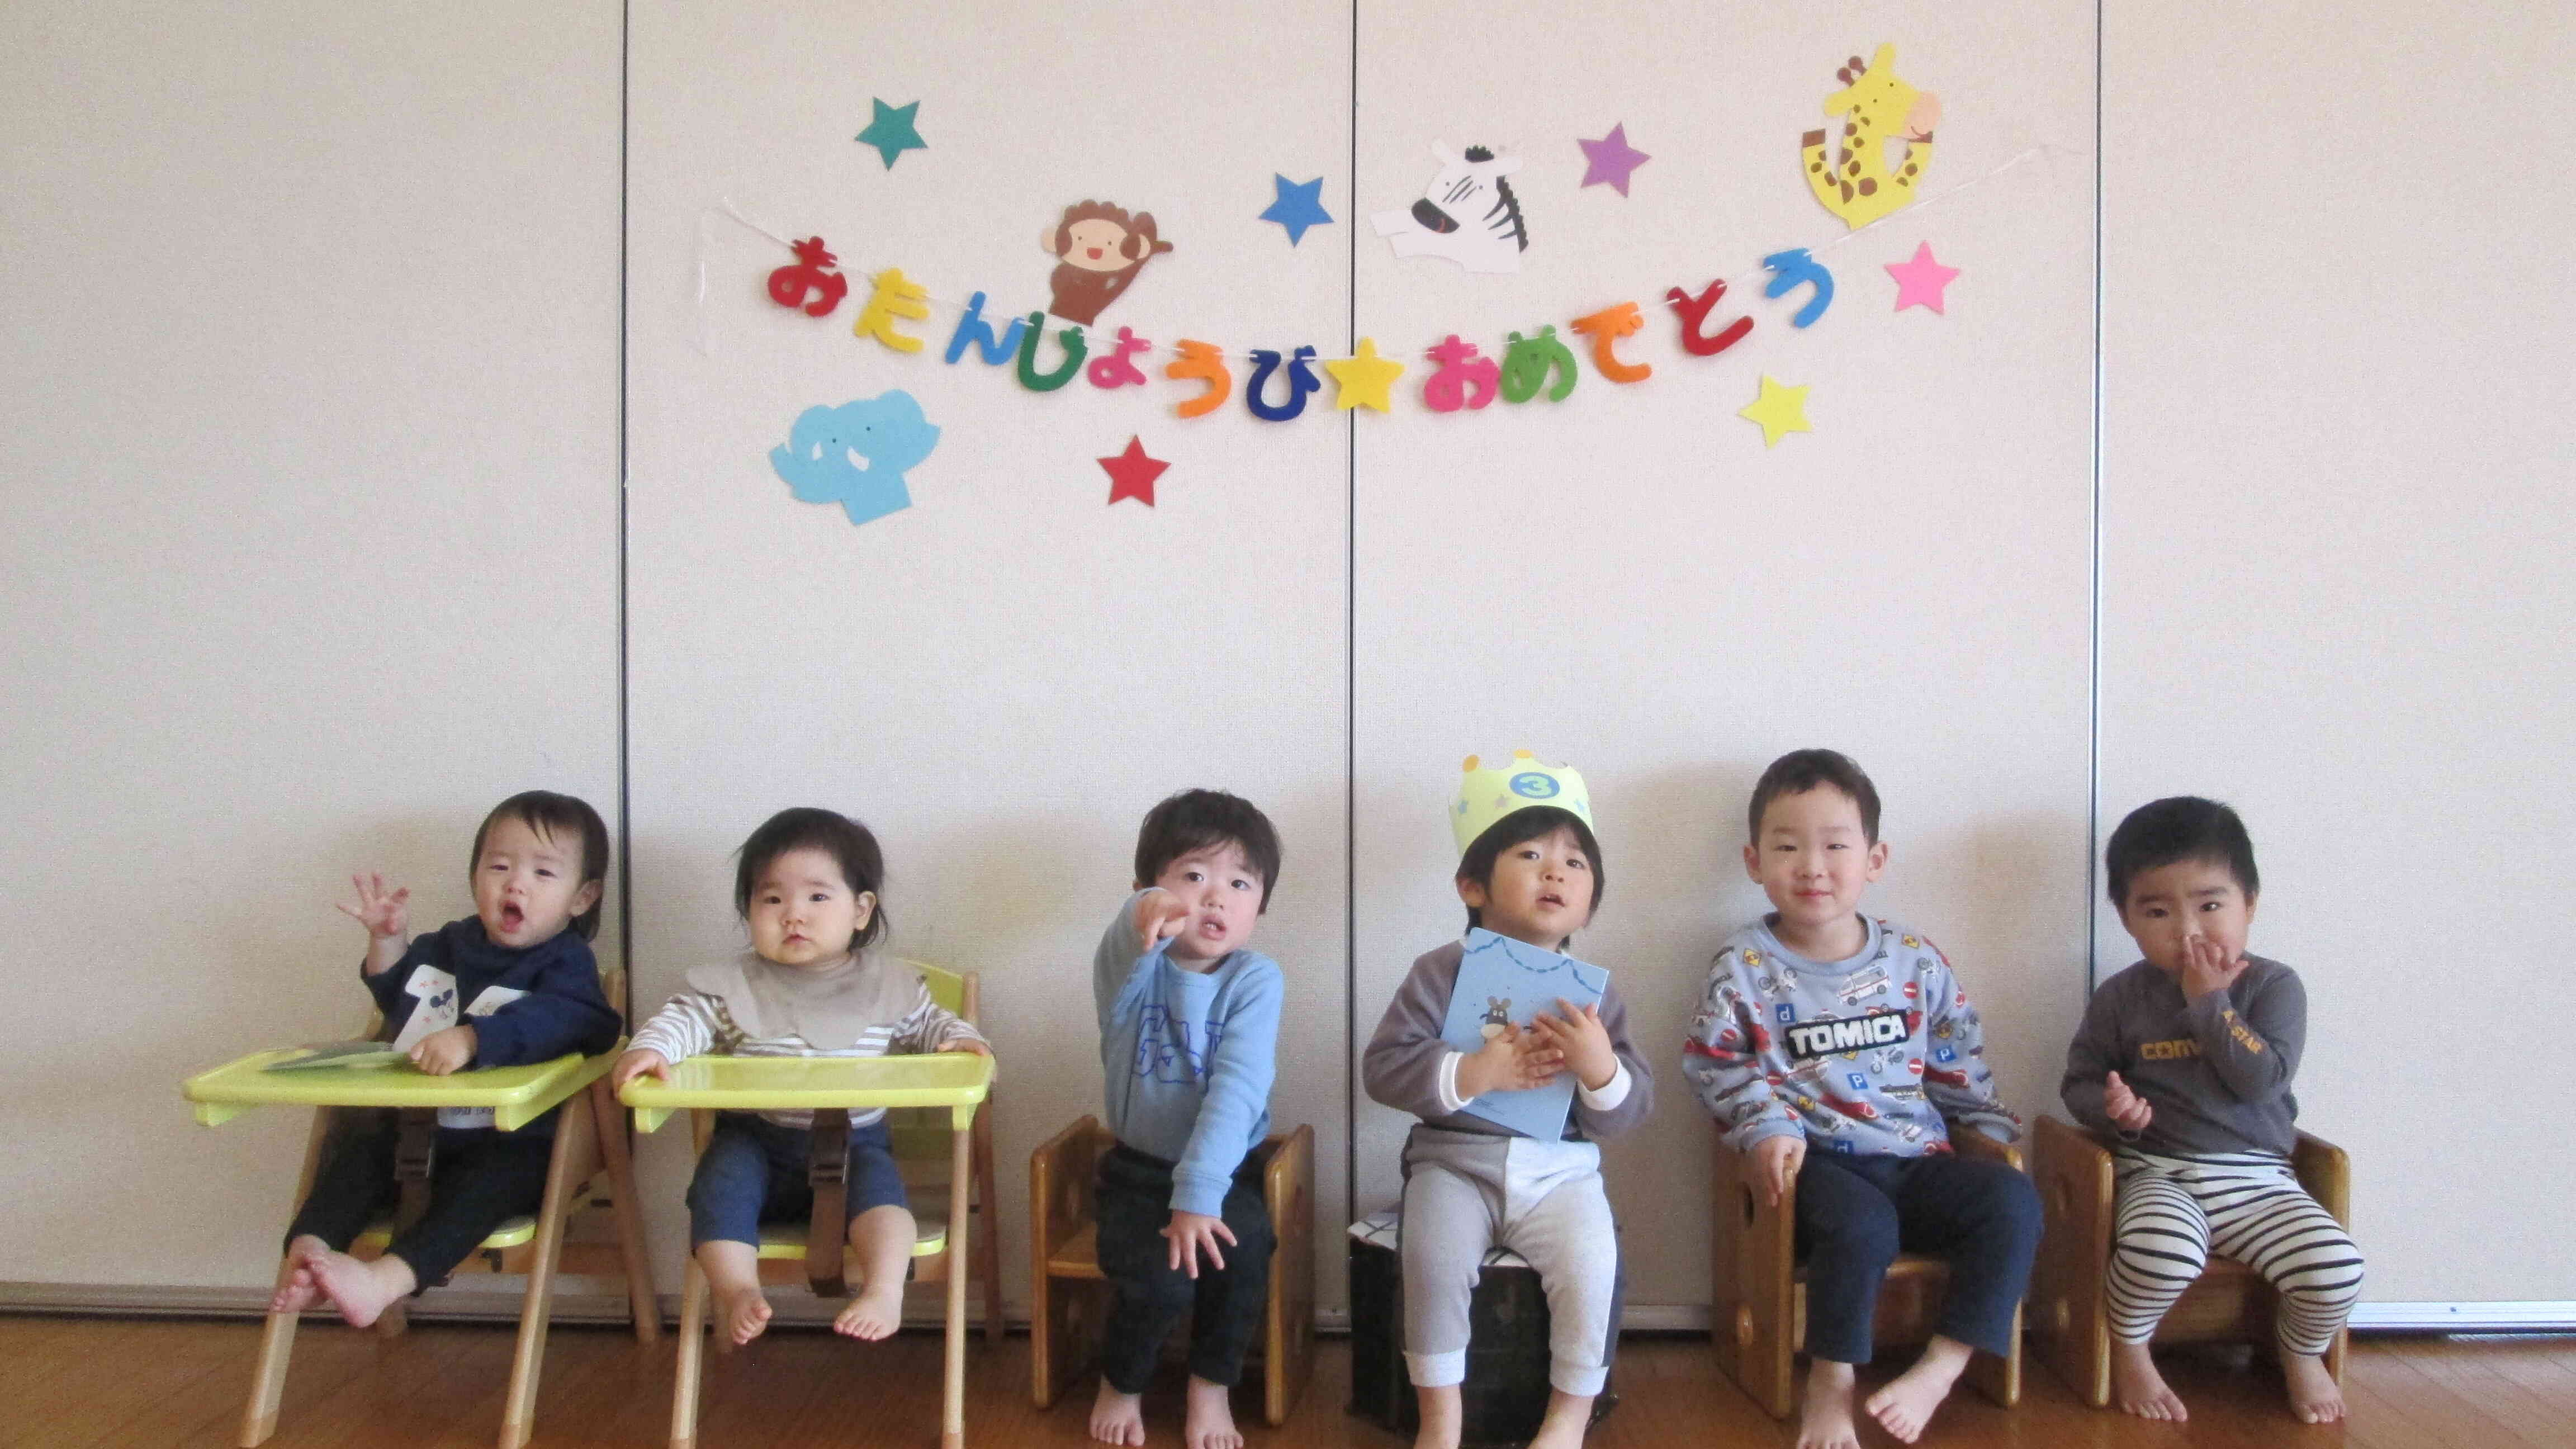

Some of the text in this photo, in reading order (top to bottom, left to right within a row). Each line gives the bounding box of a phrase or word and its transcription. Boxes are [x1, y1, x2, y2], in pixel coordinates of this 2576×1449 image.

[1519, 775, 1553, 796] 3
[1789, 1014, 1906, 1057] TOMICA
[1852, 1074, 1863, 1088] P
